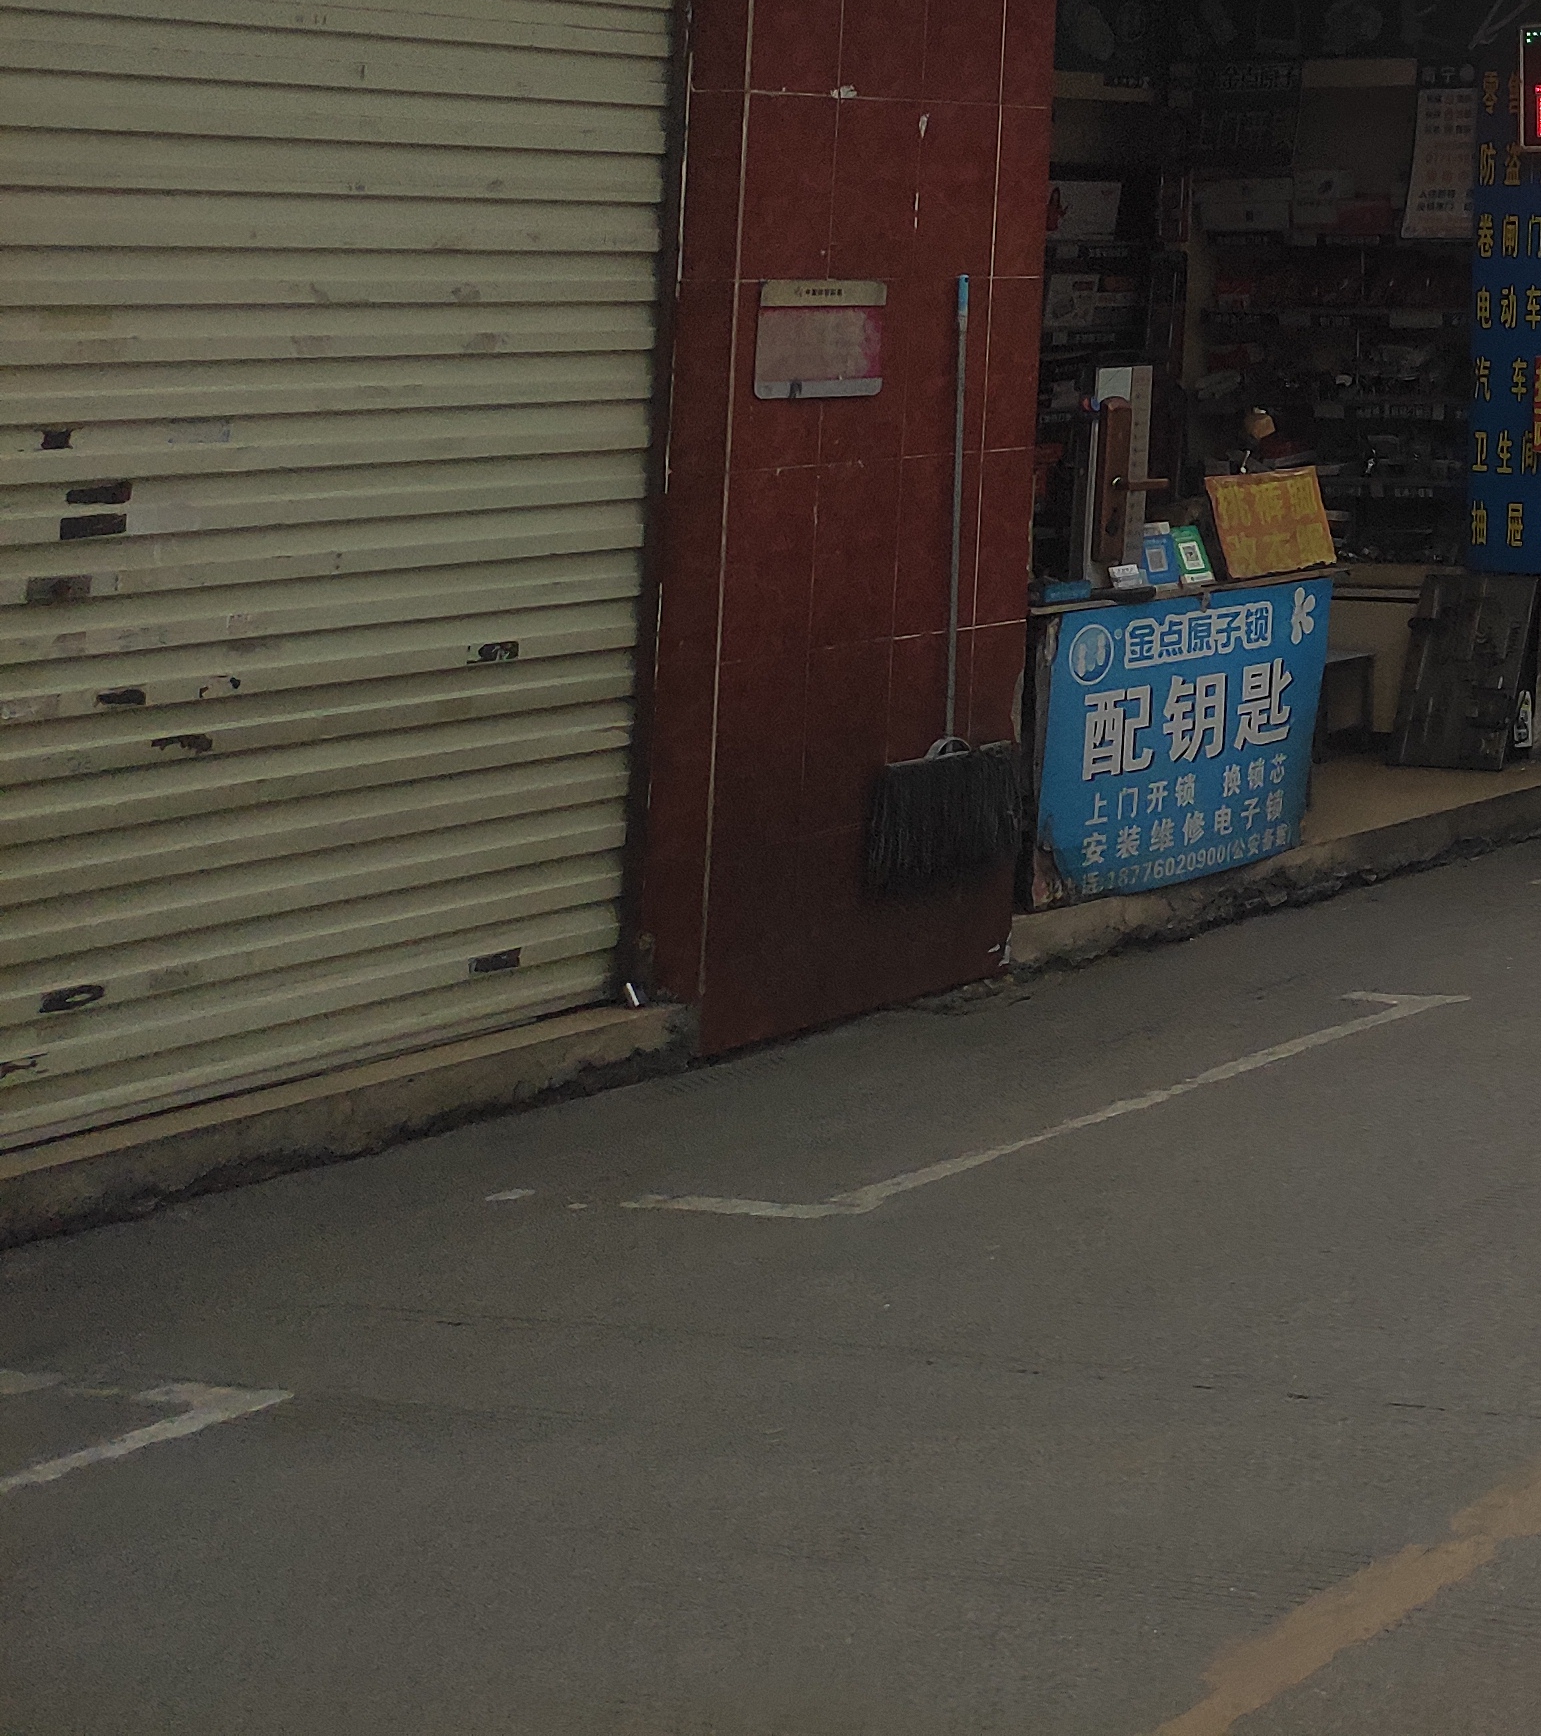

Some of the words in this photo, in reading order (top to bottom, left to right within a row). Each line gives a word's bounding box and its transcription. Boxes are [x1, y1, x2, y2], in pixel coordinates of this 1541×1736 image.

[1126, 605, 1272, 666] 金点原子锁
[1082, 658, 1293, 782] 配钥匙
[1084, 773, 1196, 827] 上门开锁
[1222, 753, 1288, 798] 换锁芯
[1081, 790, 1285, 867] 安装维修电子锁
